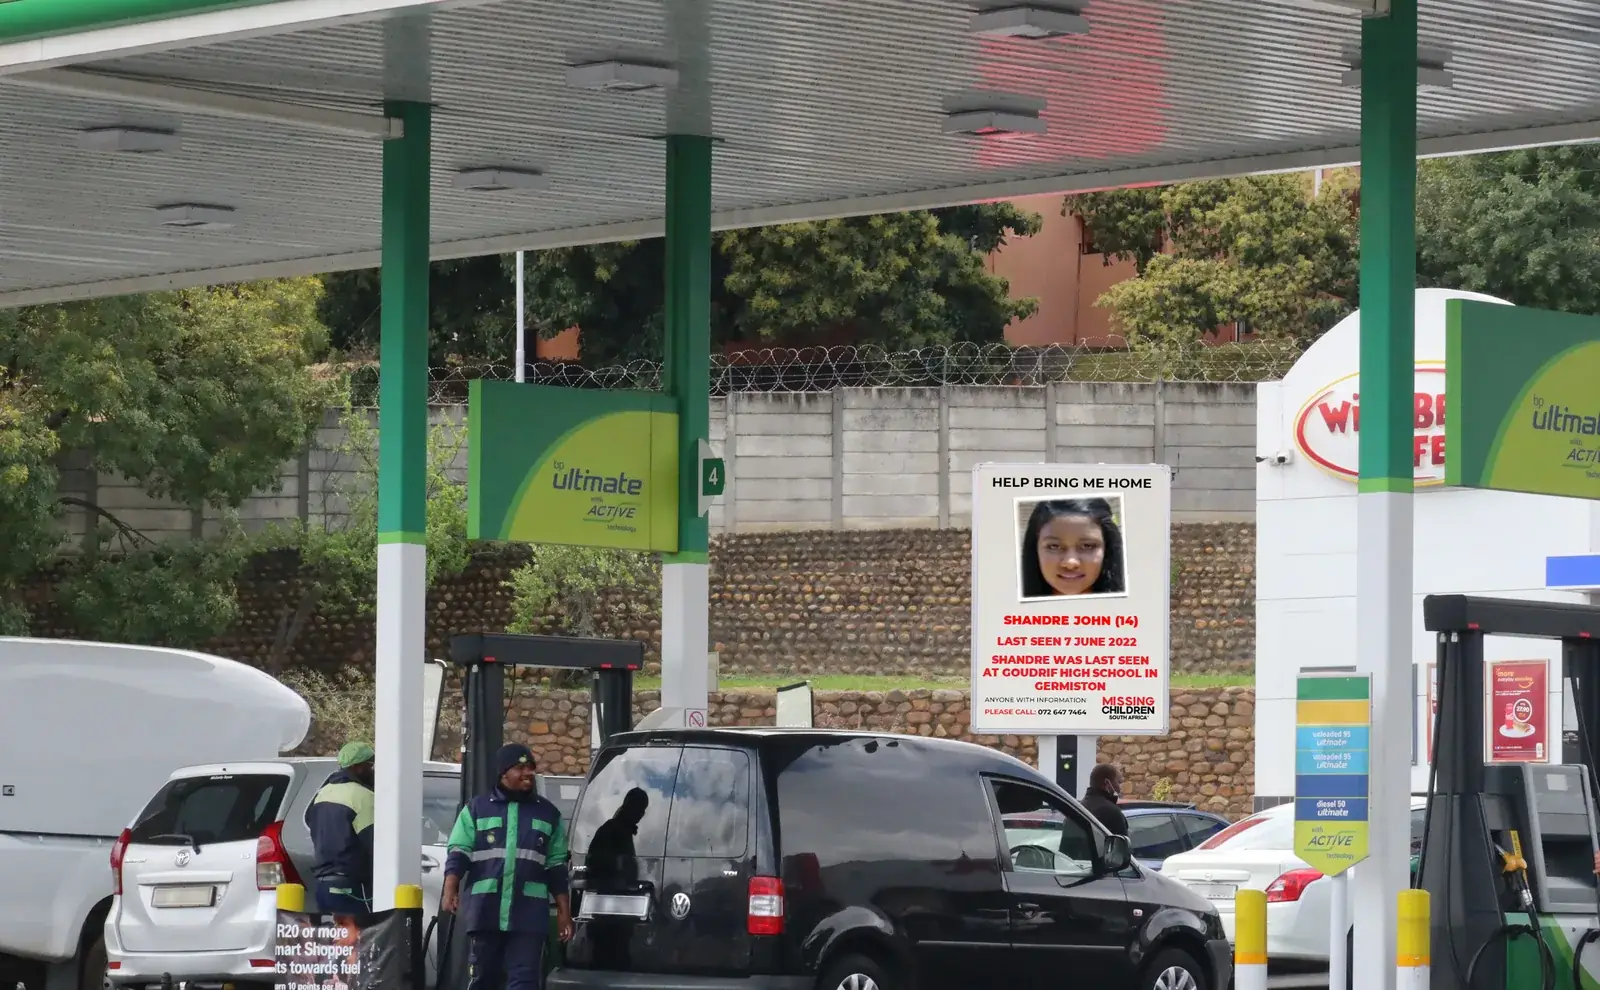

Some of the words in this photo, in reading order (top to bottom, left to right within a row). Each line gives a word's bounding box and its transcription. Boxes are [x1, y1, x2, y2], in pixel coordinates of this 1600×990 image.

[1533, 393, 1544, 408] bp
[1532, 404, 1600, 435] ultima
[553, 460, 564, 471] bp
[552, 468, 642, 496] ultimate
[708, 467, 718, 486] 4
[992, 477, 1030, 488] HELP
[1034, 478, 1079, 488] BRING
[1083, 478, 1104, 488] ME
[1108, 478, 1152, 489] HOME
[588, 504, 636, 518] ACTIVE
[1003, 615, 1069, 626] SHANDRE
[1074, 616, 1111, 626] JOHN
[1115, 616, 1138, 628] (14)
[997, 636, 1028, 646] LAST
[1030, 637, 1062, 646] SEEN
[1064, 637, 1071, 646] 7
[1074, 637, 1106, 647] JUNE
[1108, 637, 1137, 647] 2022
[992, 655, 1050, 665] SHANDRE
[1053, 656, 1083, 665] WAS
[1085, 656, 1114, 665] LAST
[1118, 656, 1150, 665] SEEN
[982, 668, 998, 677] AT
[1002, 668, 1058, 678] GOUDRIF
[1060, 668, 1091, 678] HIGH
[1092, 669, 1142, 678] SCHOOL
[1145, 669, 1158, 678] IN
[1034, 682, 1106, 691] GERMISTON
[1102, 696, 1155, 706] MISSING
[1102, 706, 1155, 714] CHILDREN
[1316, 738, 1347, 746] ultimate
[1316, 761, 1348, 769] ultimate
[1317, 808, 1349, 817] ultimate
[1308, 835, 1354, 846] ACTIVE
[1326, 852, 1354, 860] technology
[277, 924, 299, 938] R20
[302, 927, 314, 938] or
[318, 927, 348, 938] more
[304, 942, 354, 959] Shopper
[289, 960, 338, 974] towards
[340, 960, 360, 974] fuel
[288, 982, 297, 990] 10
